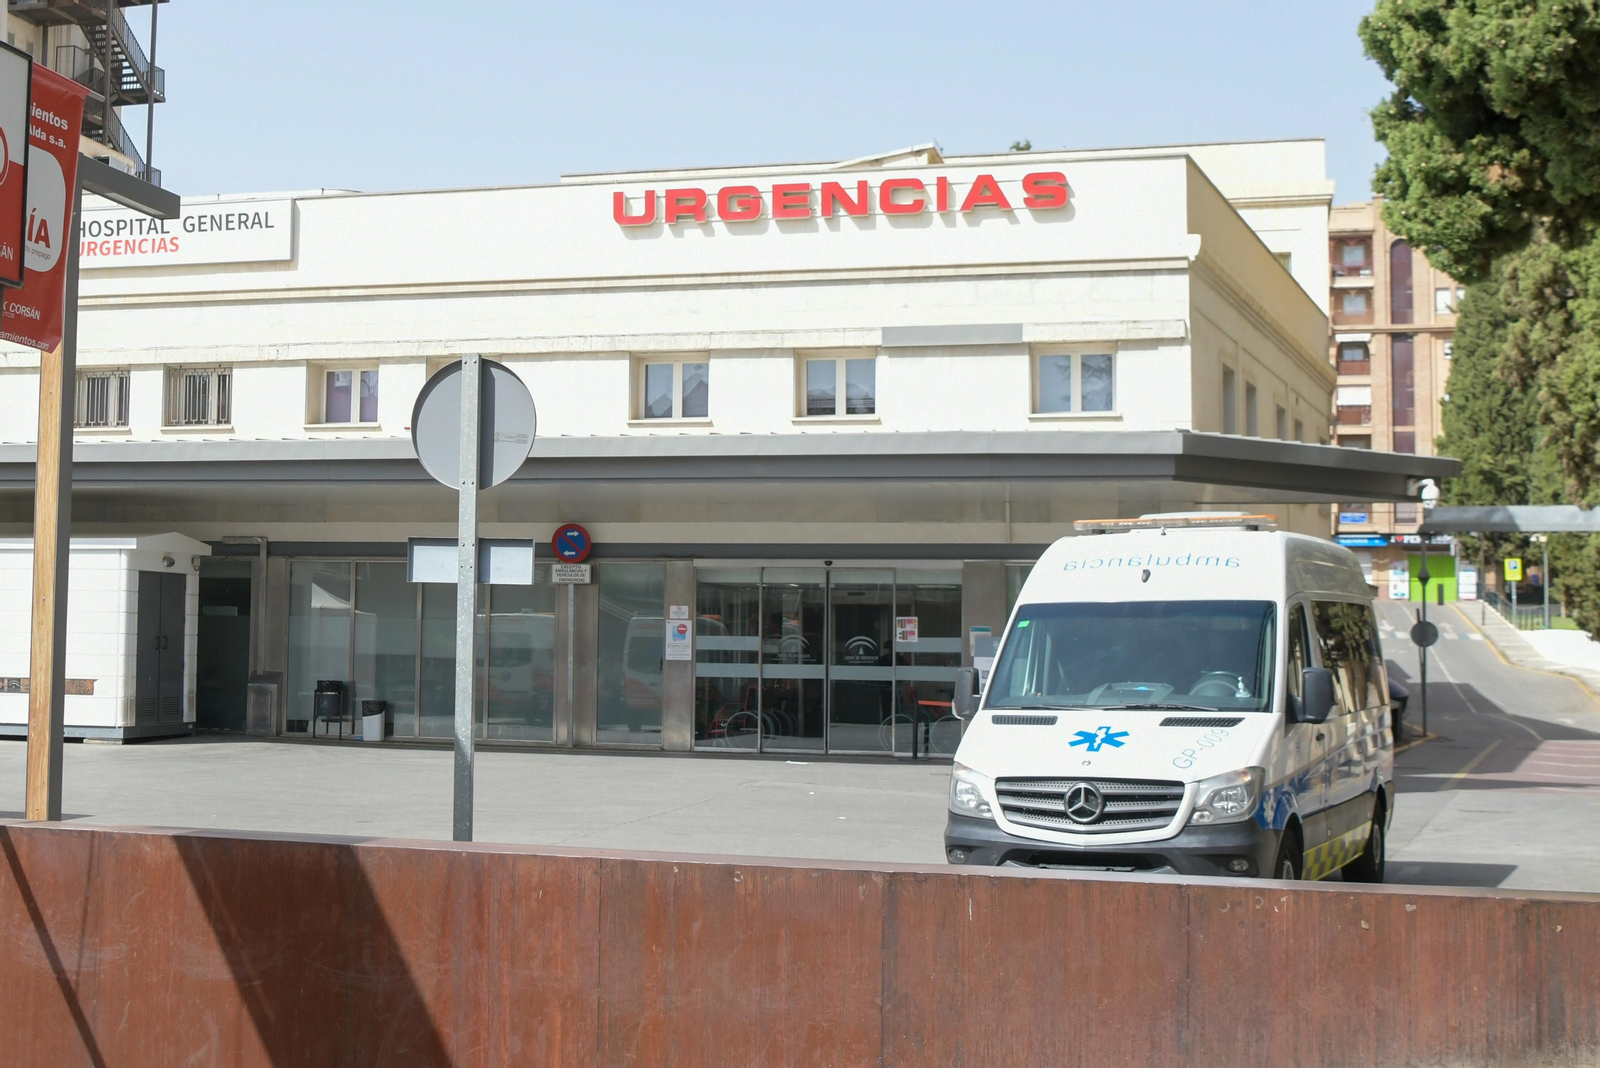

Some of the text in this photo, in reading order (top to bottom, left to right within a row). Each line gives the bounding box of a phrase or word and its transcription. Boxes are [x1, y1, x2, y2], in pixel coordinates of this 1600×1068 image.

[30, 102, 69, 130] ientos
[49, 135, 66, 149] s.a.
[613, 171, 1070, 227] URGENCIAS
[182, 211, 275, 233] GENERAL
[0, 241, 14, 261] ÁN
[9, 302, 41, 320] CORSÁN
[1172, 728, 1230, 769] GP-009
